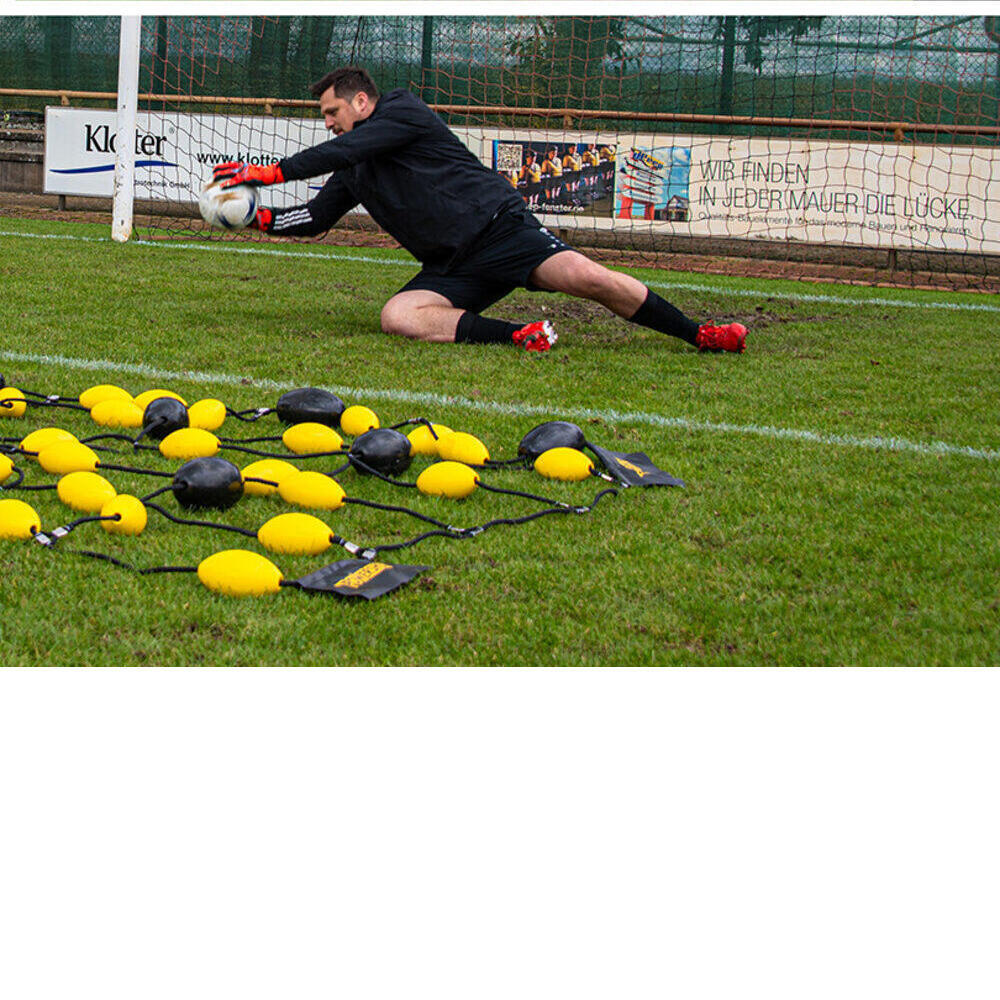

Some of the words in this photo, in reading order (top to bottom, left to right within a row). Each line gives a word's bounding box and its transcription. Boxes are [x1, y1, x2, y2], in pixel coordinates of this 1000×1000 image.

[84, 124, 168, 156] Klter
[196, 151, 284, 166] wwwklotte
[699, 159, 736, 181] WIR
[741, 160, 810, 184] FINDEN
[699, 185, 717, 206] IN
[722, 186, 783, 210] JEDER
[789, 190, 859, 214] MAUER
[866, 193, 896, 216] DIE
[868, 220, 898, 231] Bauen
[899, 223, 918, 231] und
